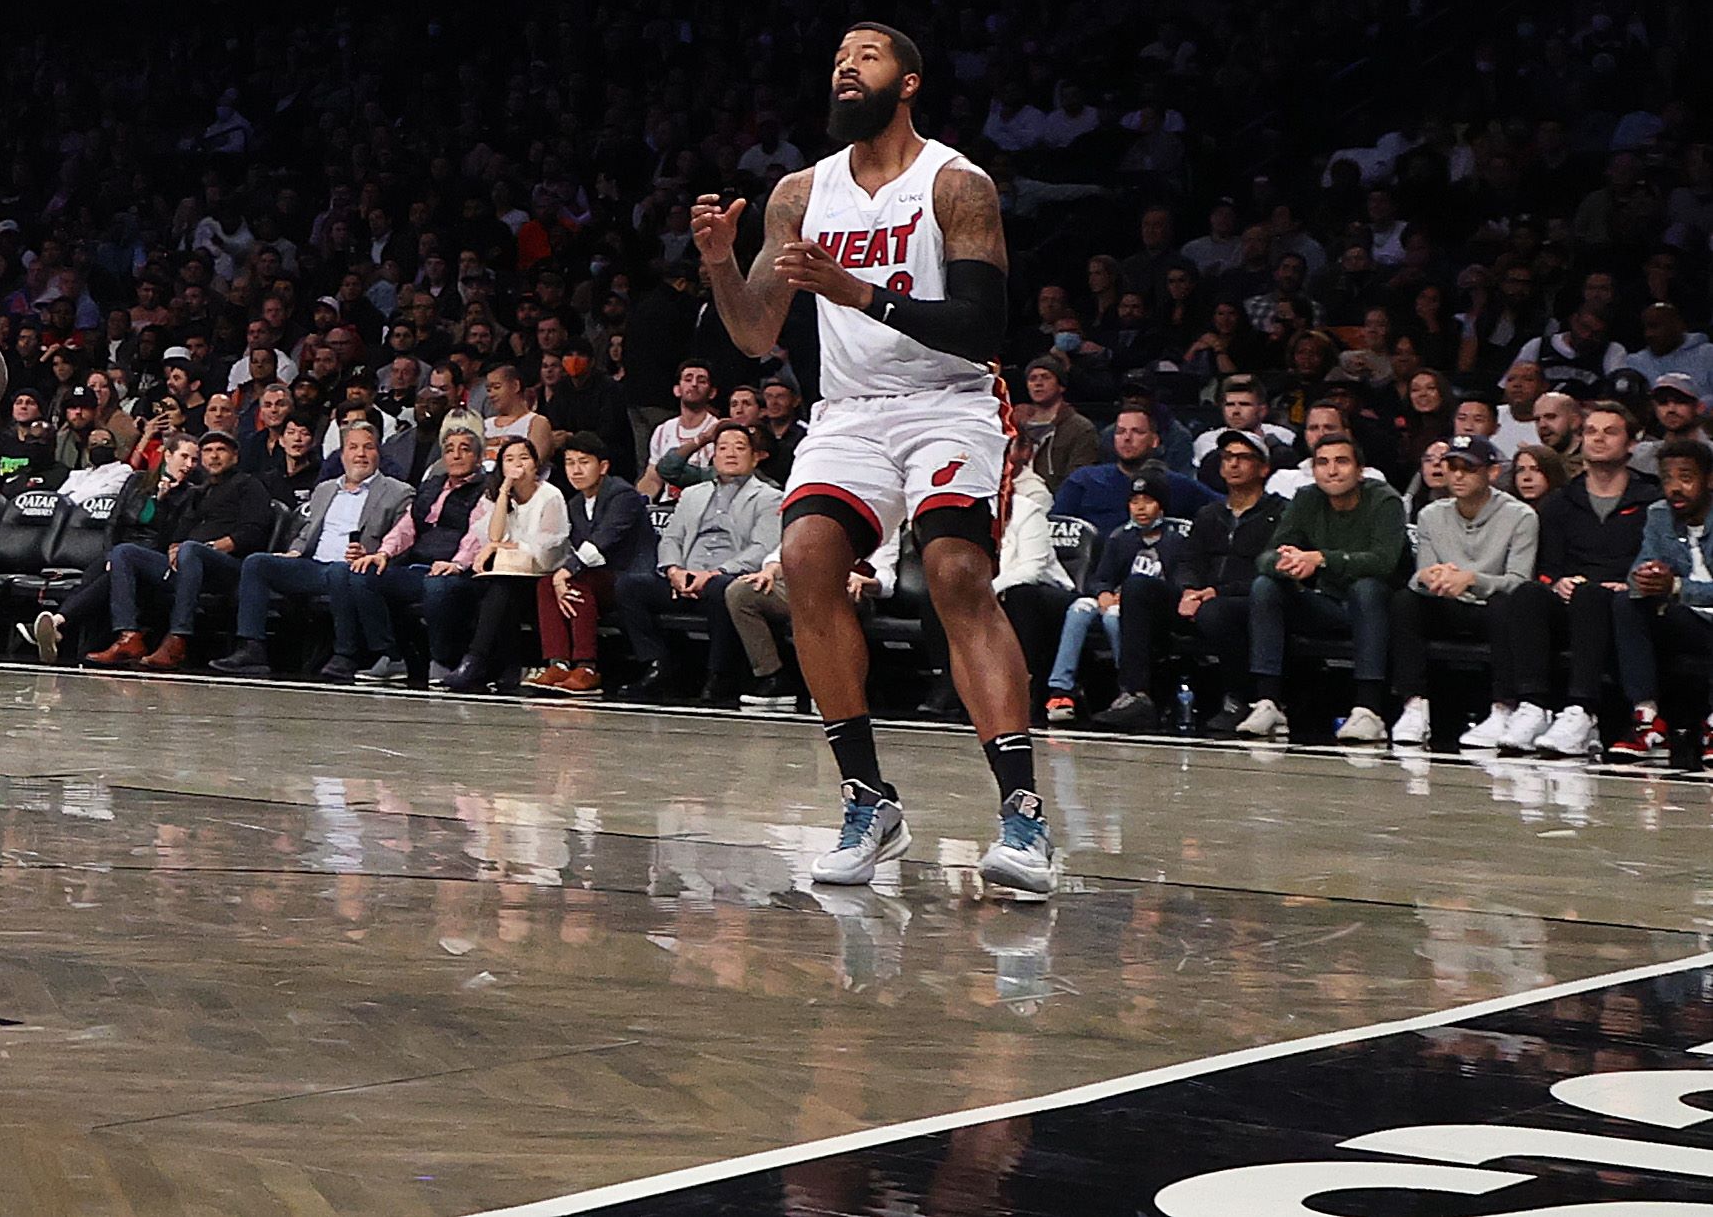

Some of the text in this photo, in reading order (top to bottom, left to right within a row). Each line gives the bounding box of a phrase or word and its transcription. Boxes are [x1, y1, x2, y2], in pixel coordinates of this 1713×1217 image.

[818, 207, 923, 269] HEAT
[15, 495, 59, 509] QATAR
[1048, 522, 1083, 536] TAR
